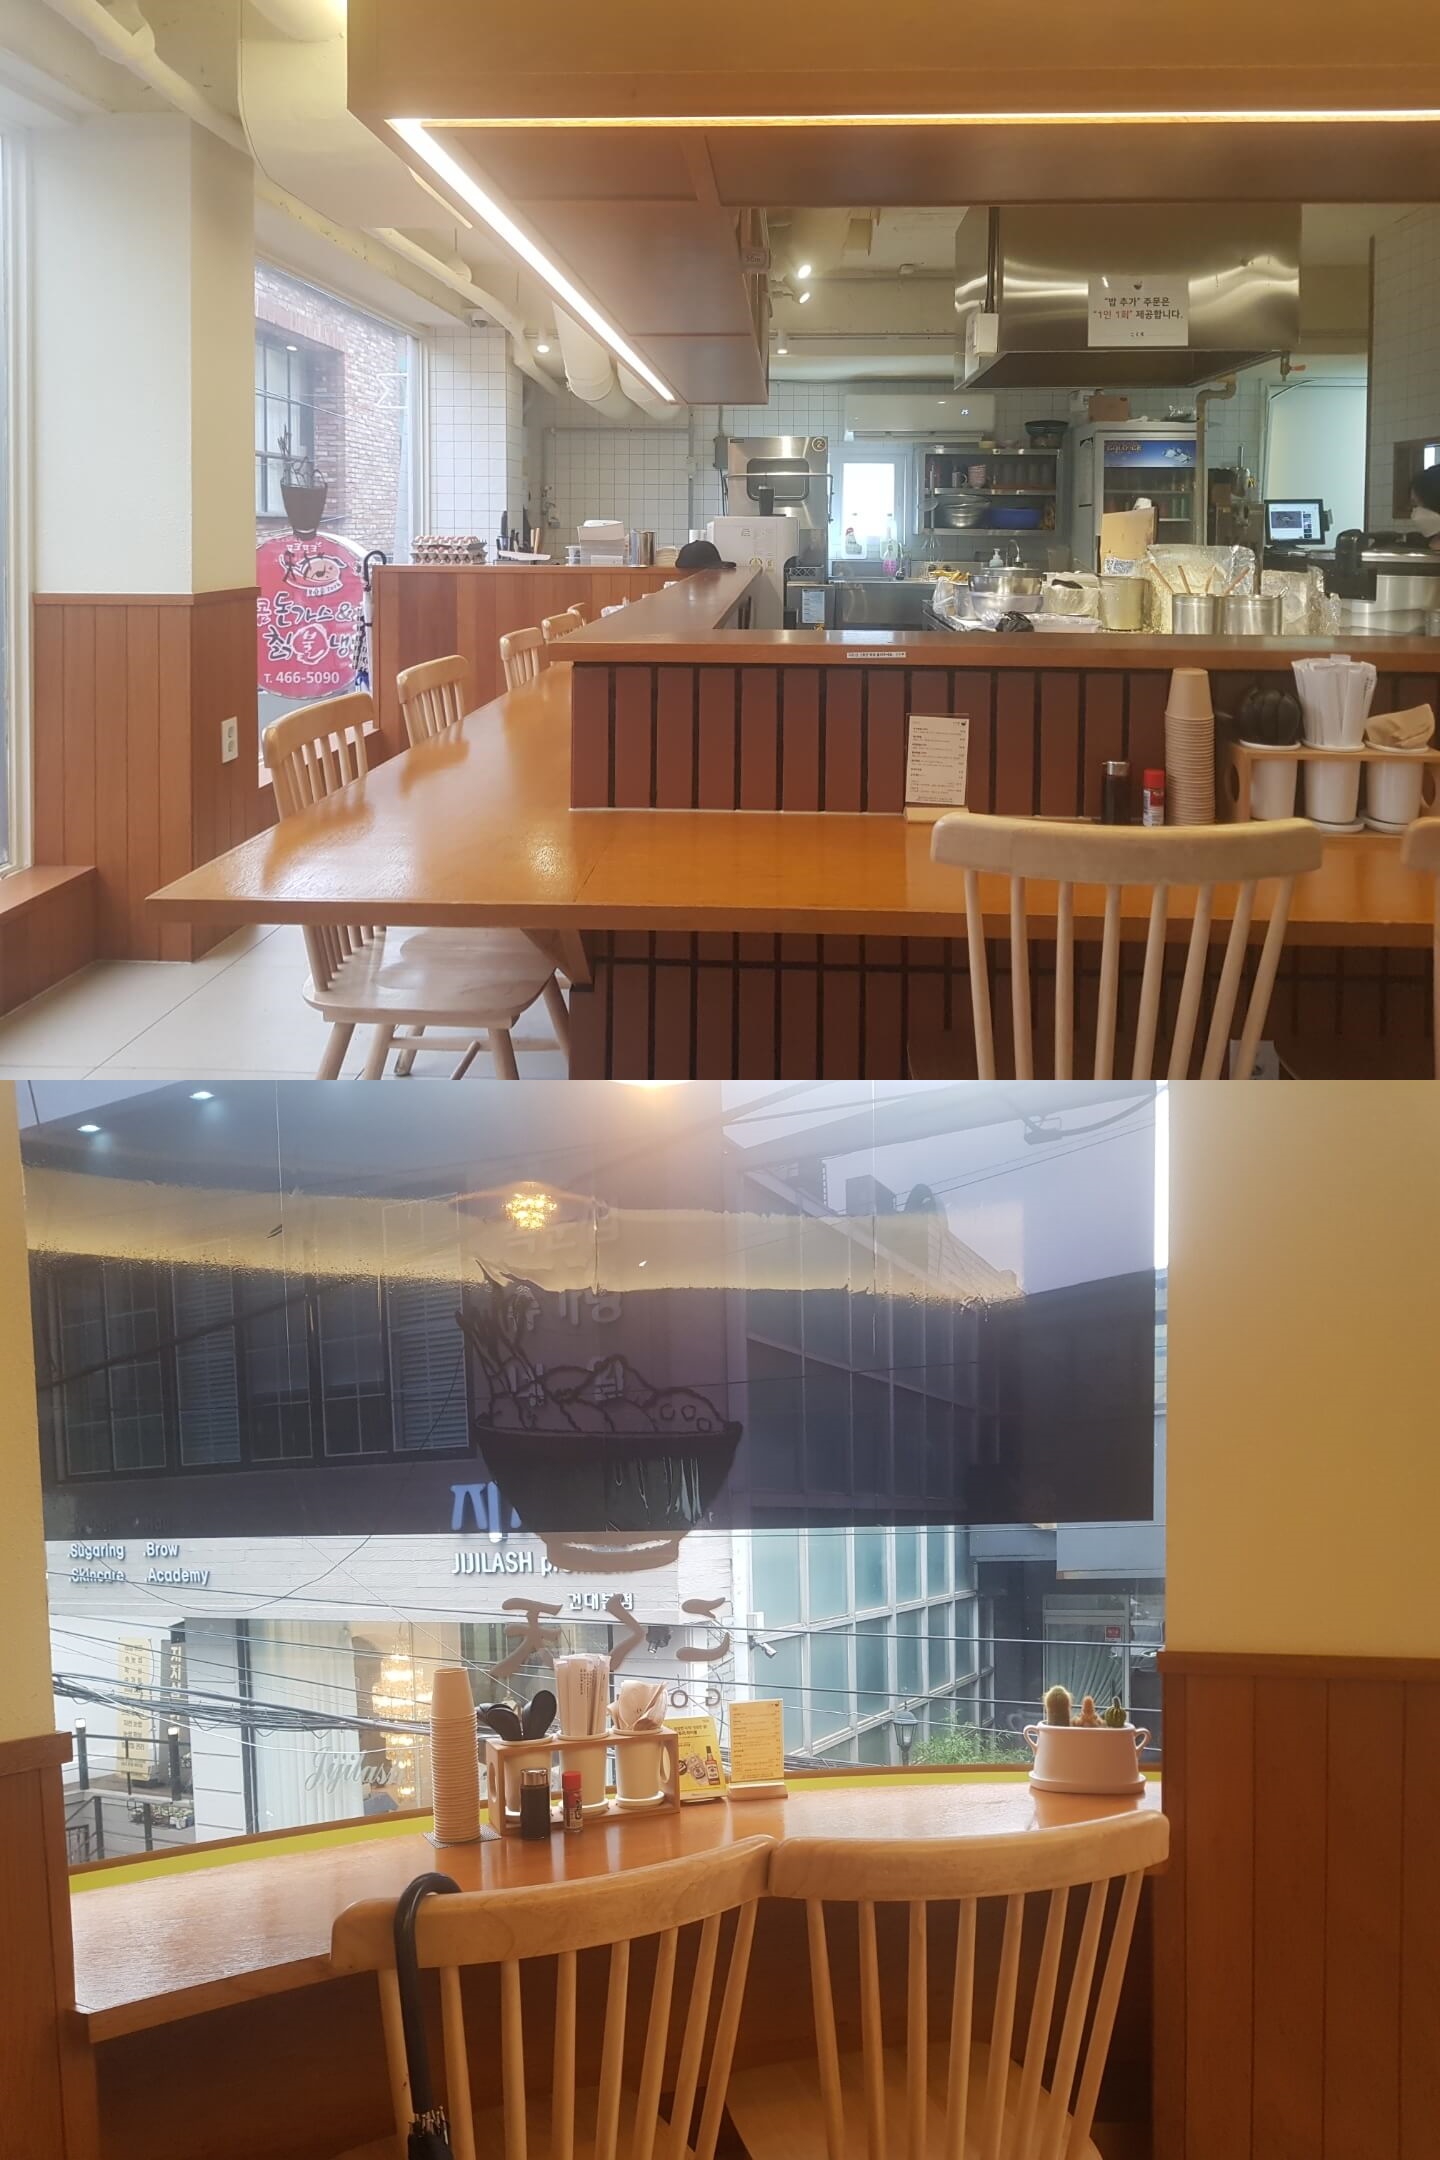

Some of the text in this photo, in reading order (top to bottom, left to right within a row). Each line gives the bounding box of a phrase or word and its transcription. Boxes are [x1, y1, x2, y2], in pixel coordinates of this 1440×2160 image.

[1143, 296, 1171, 307] 주문은
[1135, 308, 1184, 320] 제공합니다.
[262, 624, 356, 665] 칡불냉
[275, 671, 340, 685] 466-5090
[452, 1551, 534, 1575] JIJILASH
